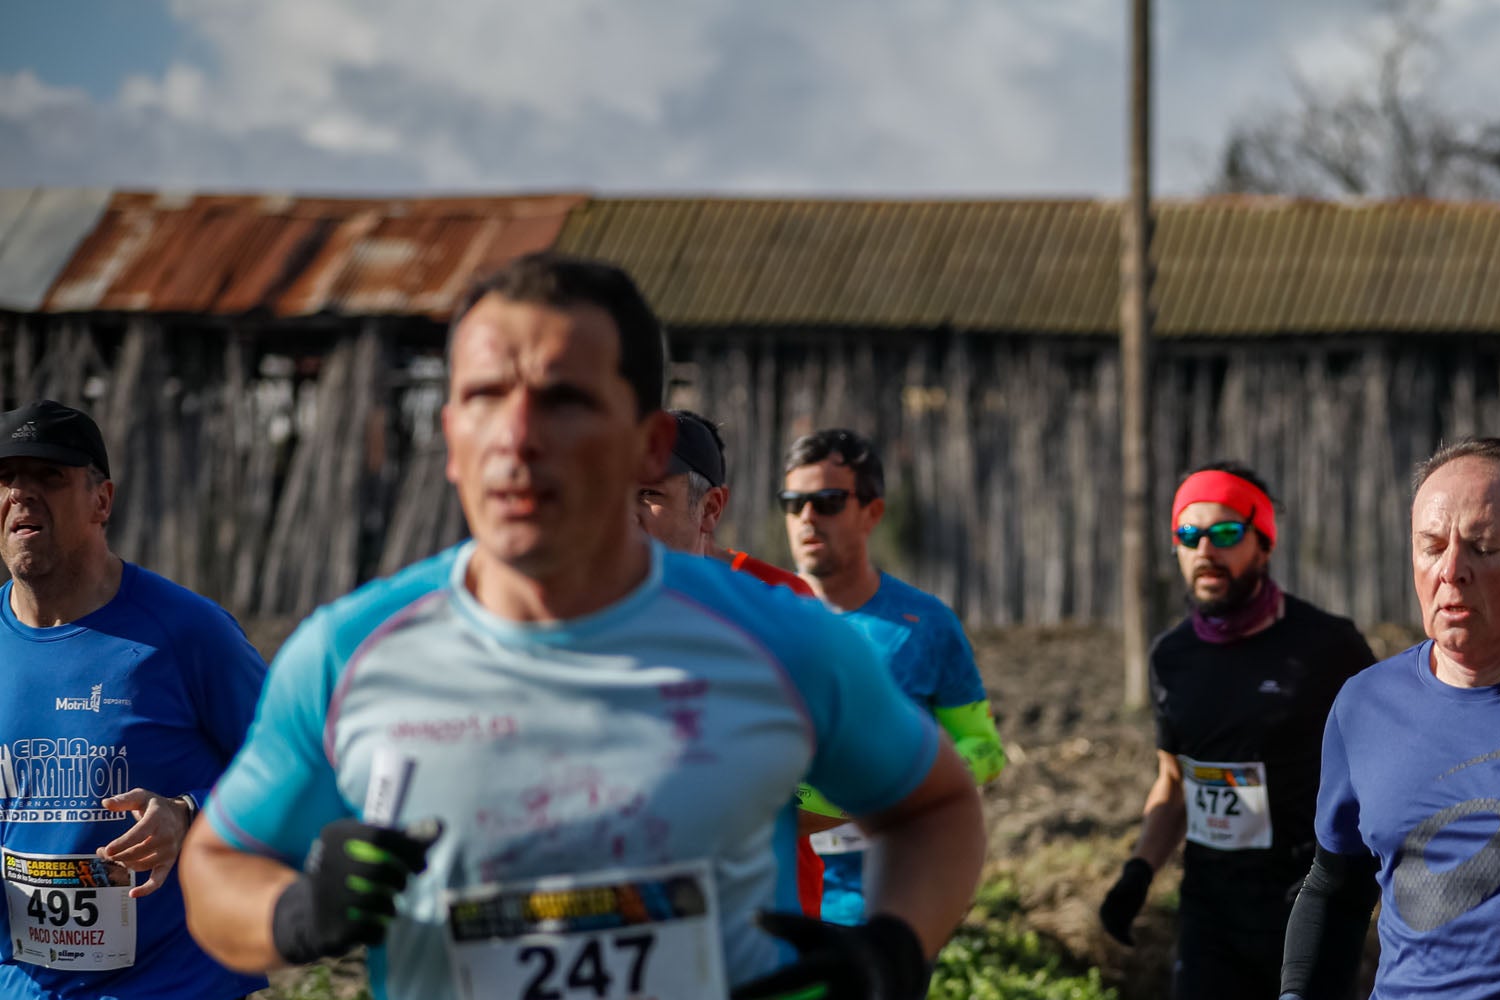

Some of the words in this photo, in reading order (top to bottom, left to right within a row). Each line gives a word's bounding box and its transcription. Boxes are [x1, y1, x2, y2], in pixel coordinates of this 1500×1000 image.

[90, 745, 128, 757] 2014
[44, 810, 62, 820] DE
[66, 809, 125, 820] MOTRIL
[27, 861, 75, 870] CARRERA
[28, 869, 75, 878] POPULAR
[27, 888, 99, 927] 495
[29, 926, 50, 944] PACO
[52, 927, 105, 945] SÁNCHEZ
